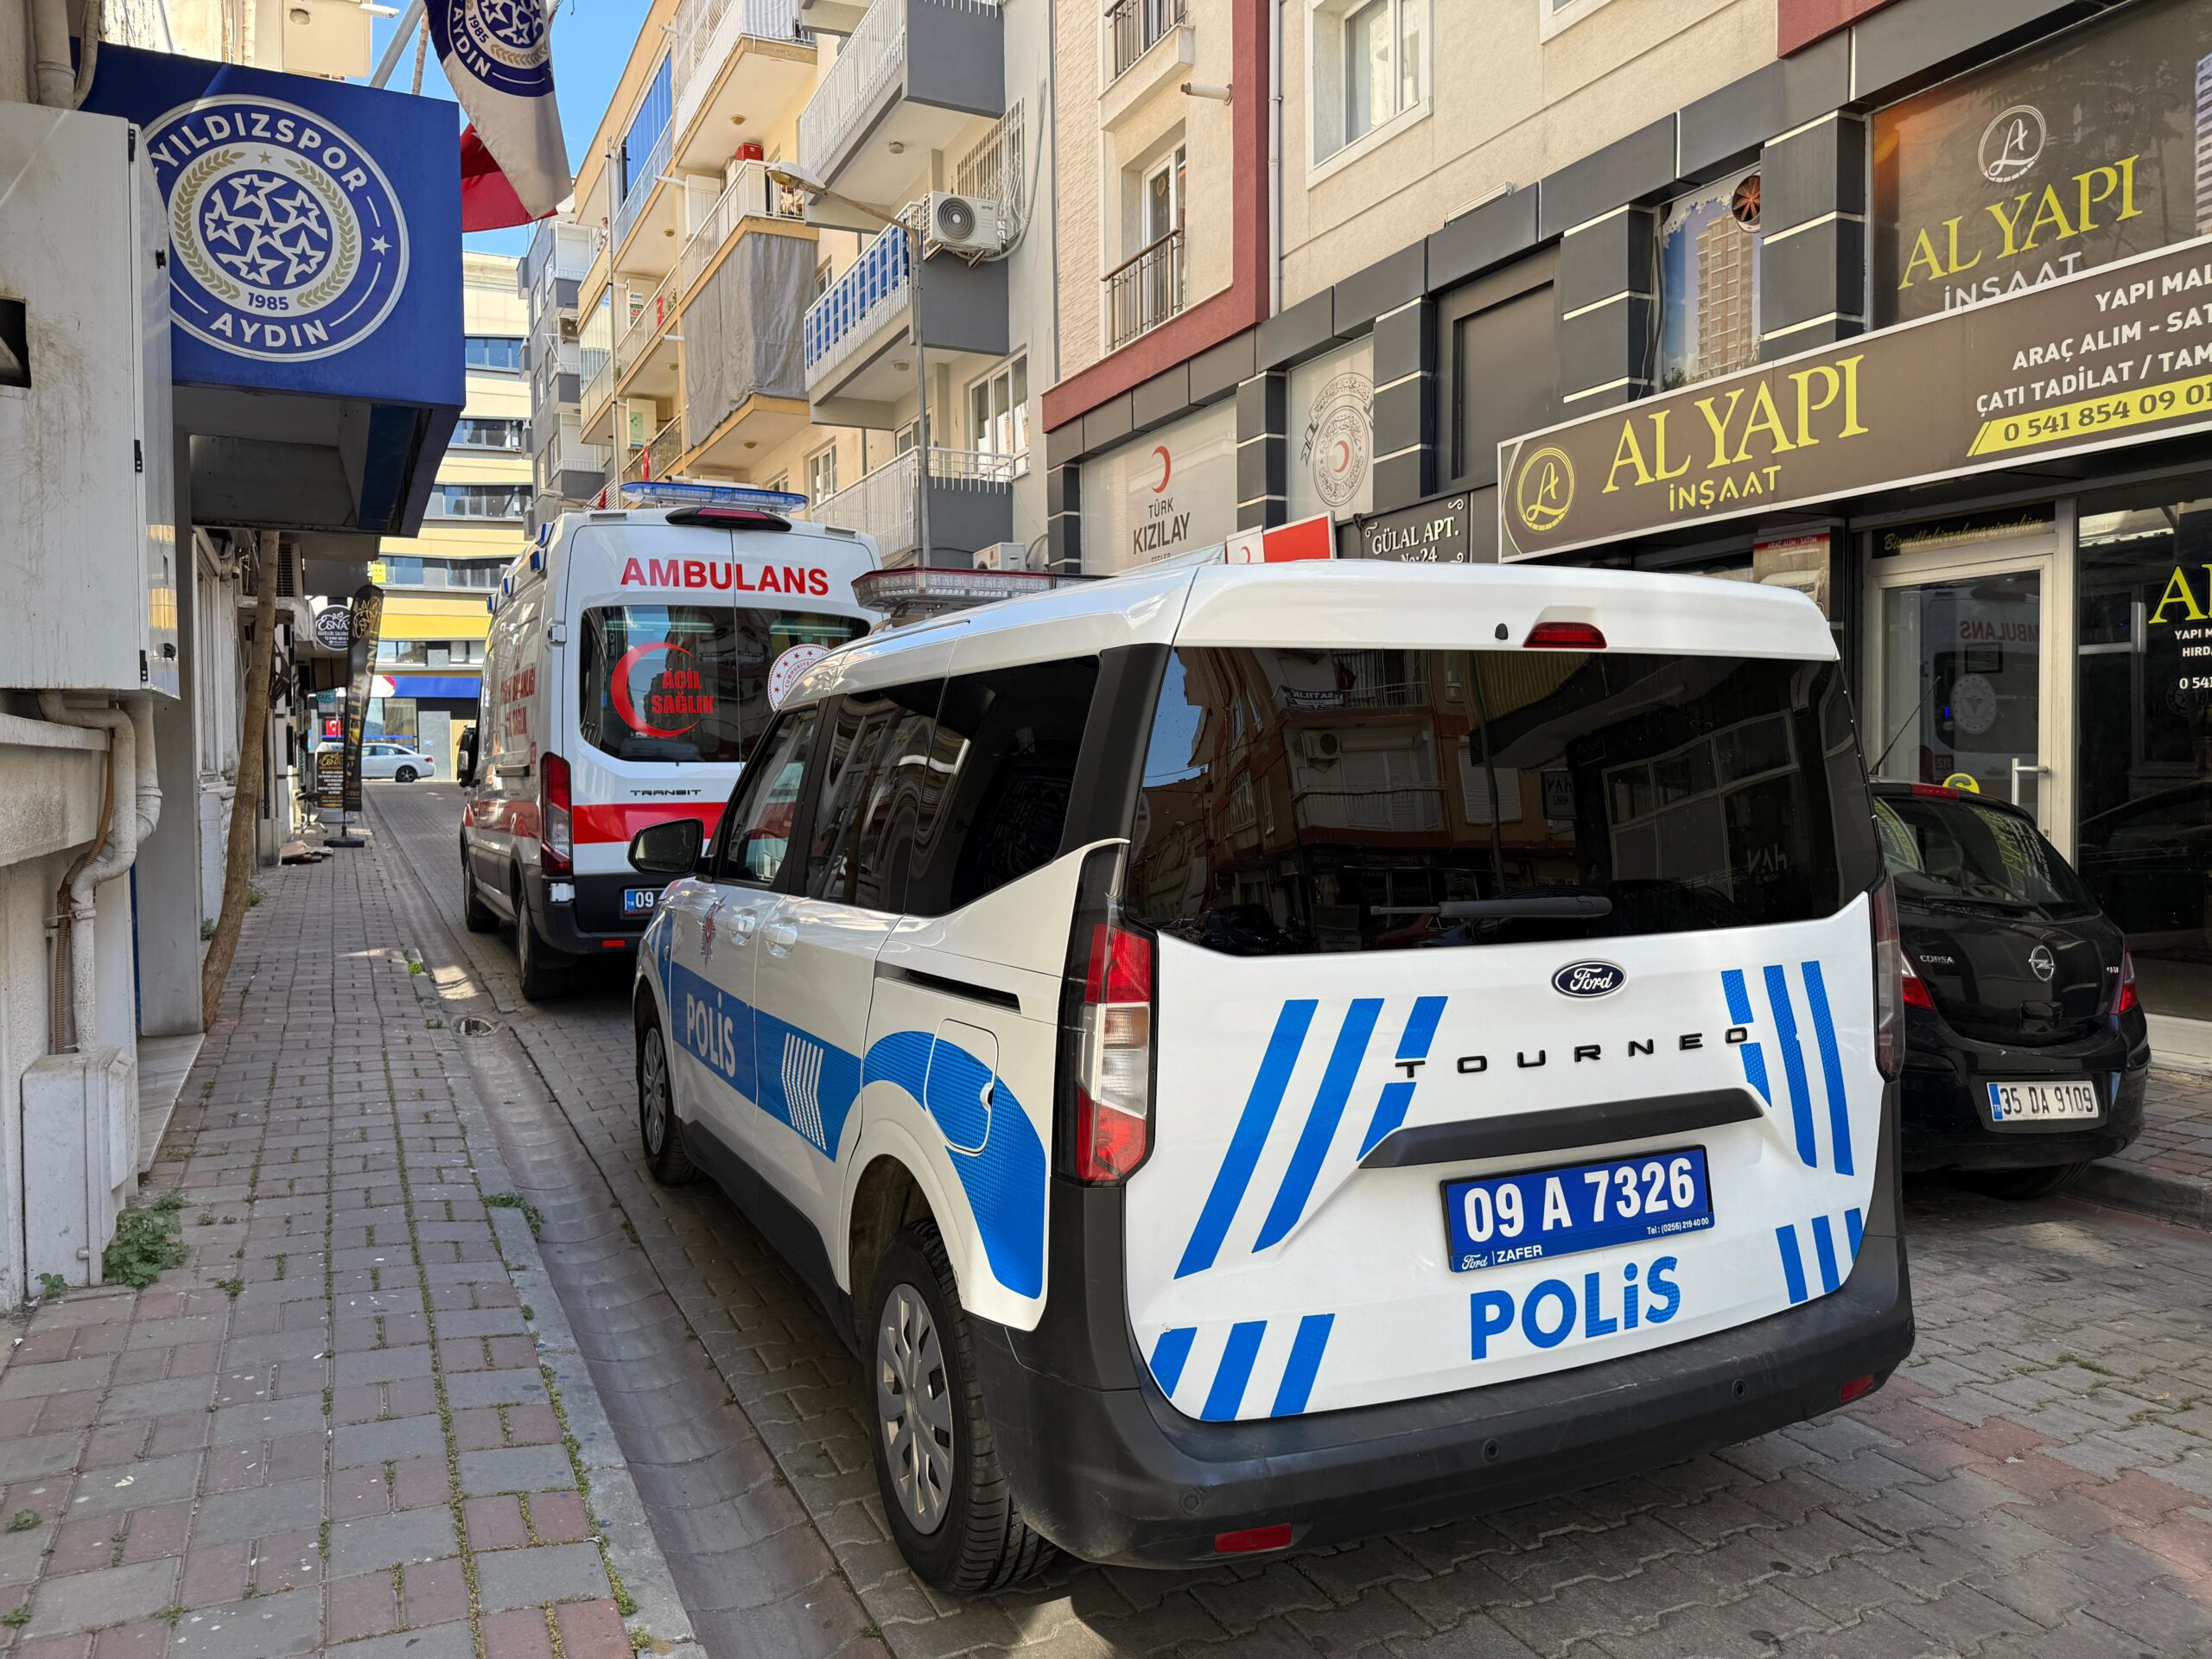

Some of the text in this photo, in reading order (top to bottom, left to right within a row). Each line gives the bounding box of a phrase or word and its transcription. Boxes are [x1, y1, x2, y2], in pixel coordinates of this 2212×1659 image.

[453, 7, 492, 78] AYDIN
[467, 14, 489, 44] 1985
[1897, 154, 2143, 290] AL YAPI
[247, 292, 290, 312] 1985
[2095, 279, 2154, 312] YAPI
[209, 312, 330, 348] AYDIN
[2012, 338, 2075, 371] ARAÇ
[2080, 321, 2142, 354] ALIM
[1976, 387, 2024, 416] ÇATI
[2031, 360, 2134, 400] TADİLAT
[1602, 354, 1870, 494] AL YAPI
[2004, 423, 2019, 442] 0
[2027, 411, 2069, 438] 541
[2078, 400, 2130, 427] 854
[2139, 390, 2176, 414] 09
[1148, 498, 1174, 519] TÜRK
[1133, 512, 1191, 555] KIZILAY
[1371, 517, 1459, 555] GÜLAL APT.
[620, 557, 830, 596] AMBULANS
[2175, 629, 2202, 640] YAPI
[2182, 646, 2212, 658] HIRD
[662, 667, 702, 690] ACİL
[785, 660, 815, 689] CUMHURİYE
[2179, 677, 2189, 689] 0
[651, 691, 715, 714] SAĞLIK
[635, 891, 654, 908] 09
[1920, 955, 1955, 964] CORSA
[1571, 967, 1614, 992] Ford
[1396, 1026, 1750, 1079] TOURNEO
[1999, 1087, 2023, 1115] 35
[2030, 1087, 2050, 1114] DA
[2055, 1086, 2094, 1113] 9109
[1464, 1157, 1694, 1243] 09 A 7326
[1661, 1221, 1681, 1234] (0256)
[1681, 1220, 1693, 1230] 219
[1693, 1218, 1701, 1227] 40
[1700, 1217, 1709, 1225] 00
[1461, 1244, 1542, 1270] Ford ZAFER
